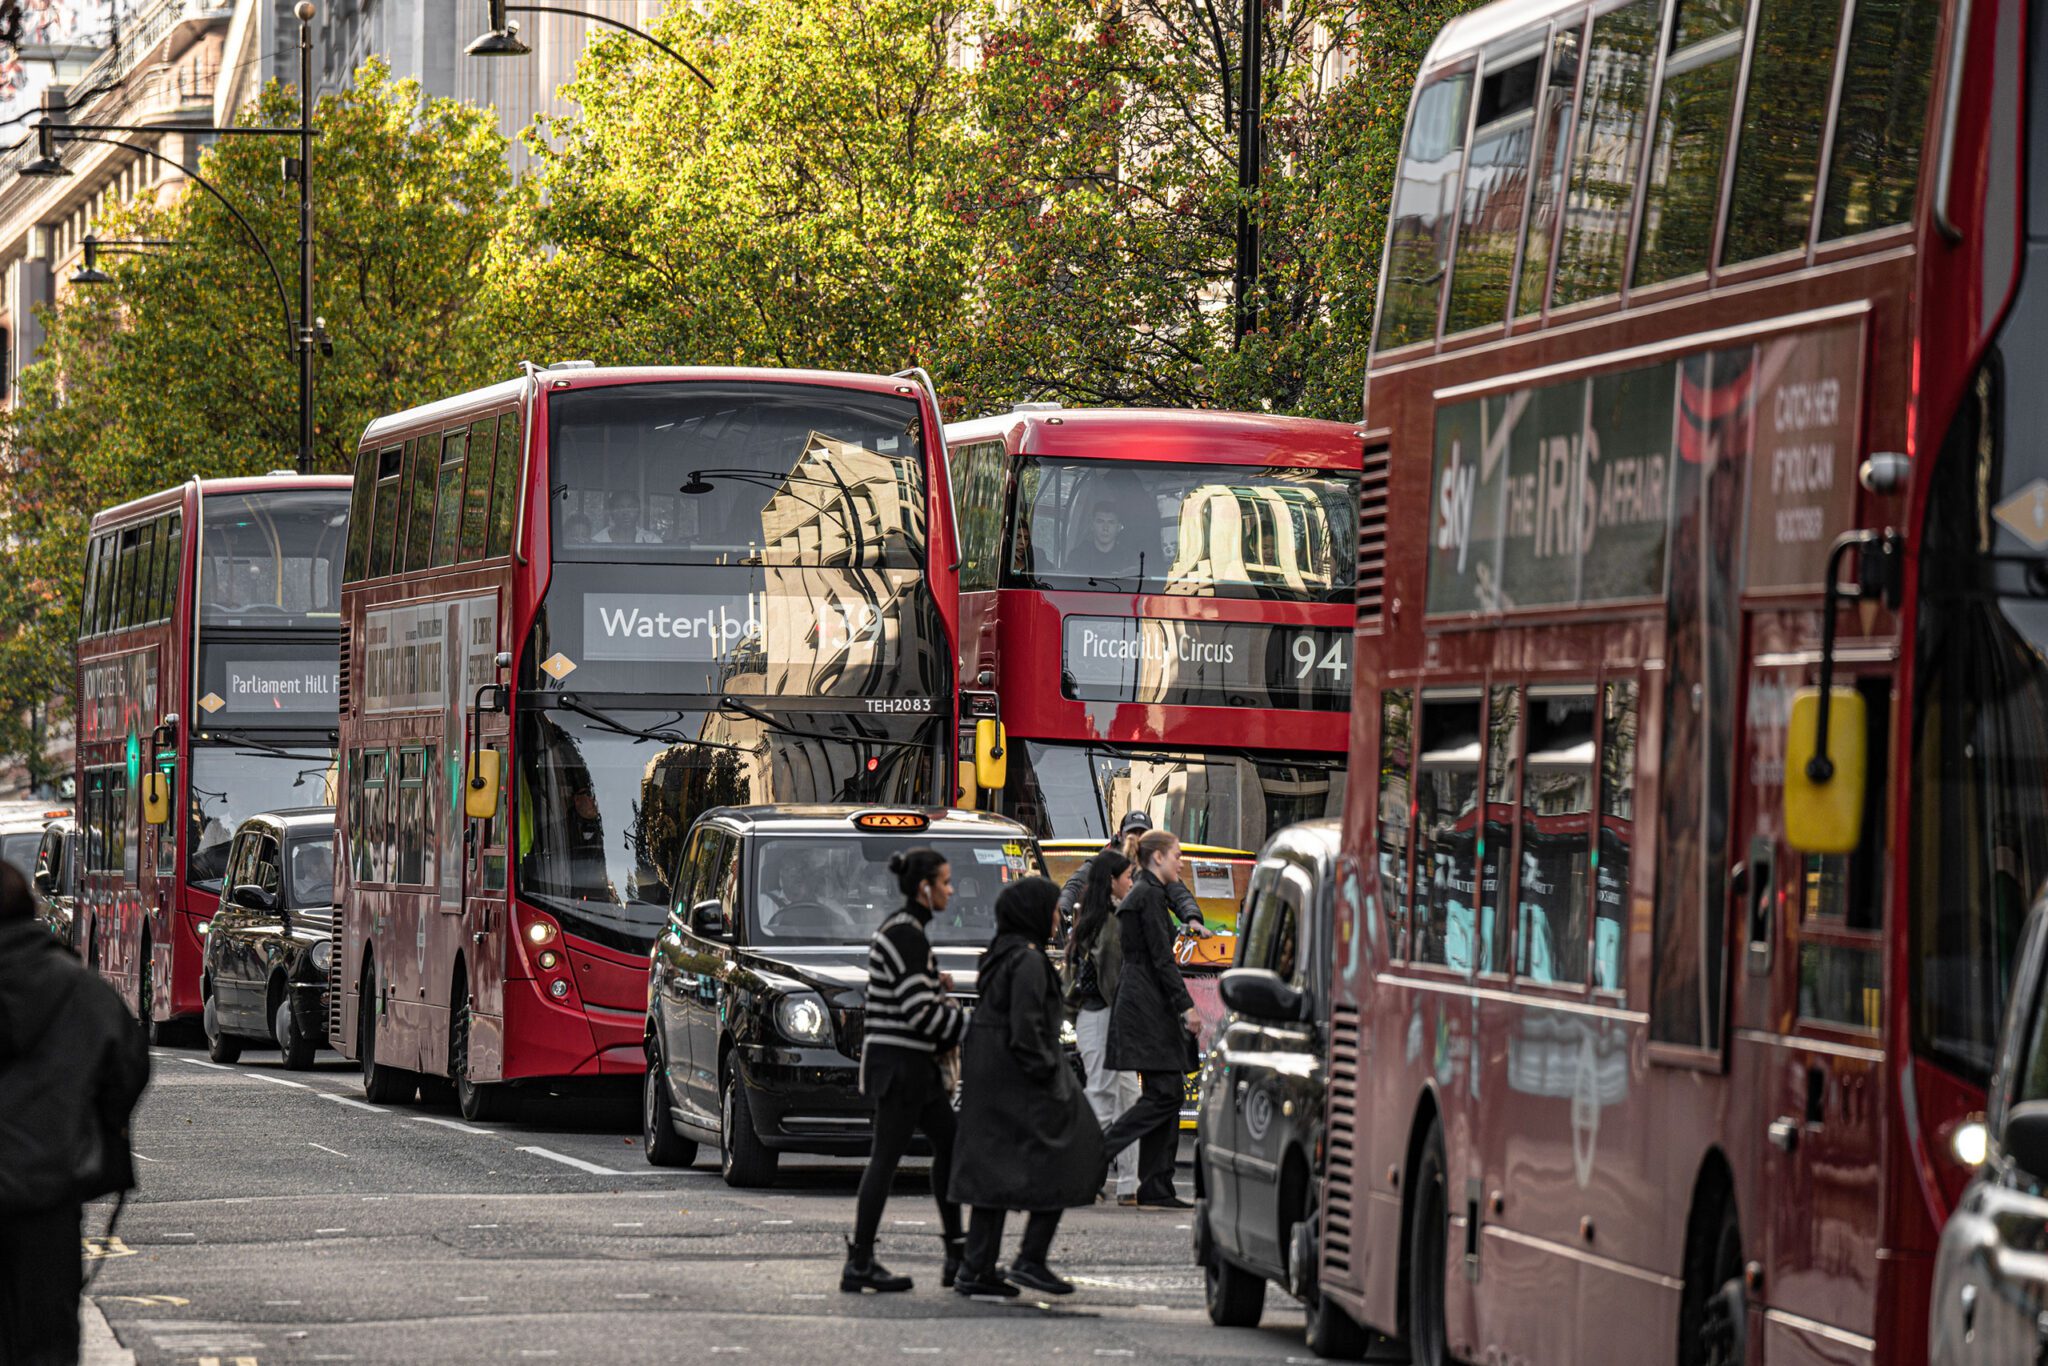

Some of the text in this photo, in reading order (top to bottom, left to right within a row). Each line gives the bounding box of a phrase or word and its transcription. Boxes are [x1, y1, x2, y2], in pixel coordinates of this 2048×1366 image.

[1438, 440, 1476, 574] sky
[1506, 425, 1665, 558] THE IRIS AFFAIR
[599, 607, 762, 639] Waterloo
[1178, 634, 1234, 664] Circus
[1292, 635, 1347, 681] 94
[232, 674, 300, 694] Parliament
[305, 674, 328, 694] Hill
[865, 699, 931, 712] TEH2083
[866, 816, 918, 825] TAXI
